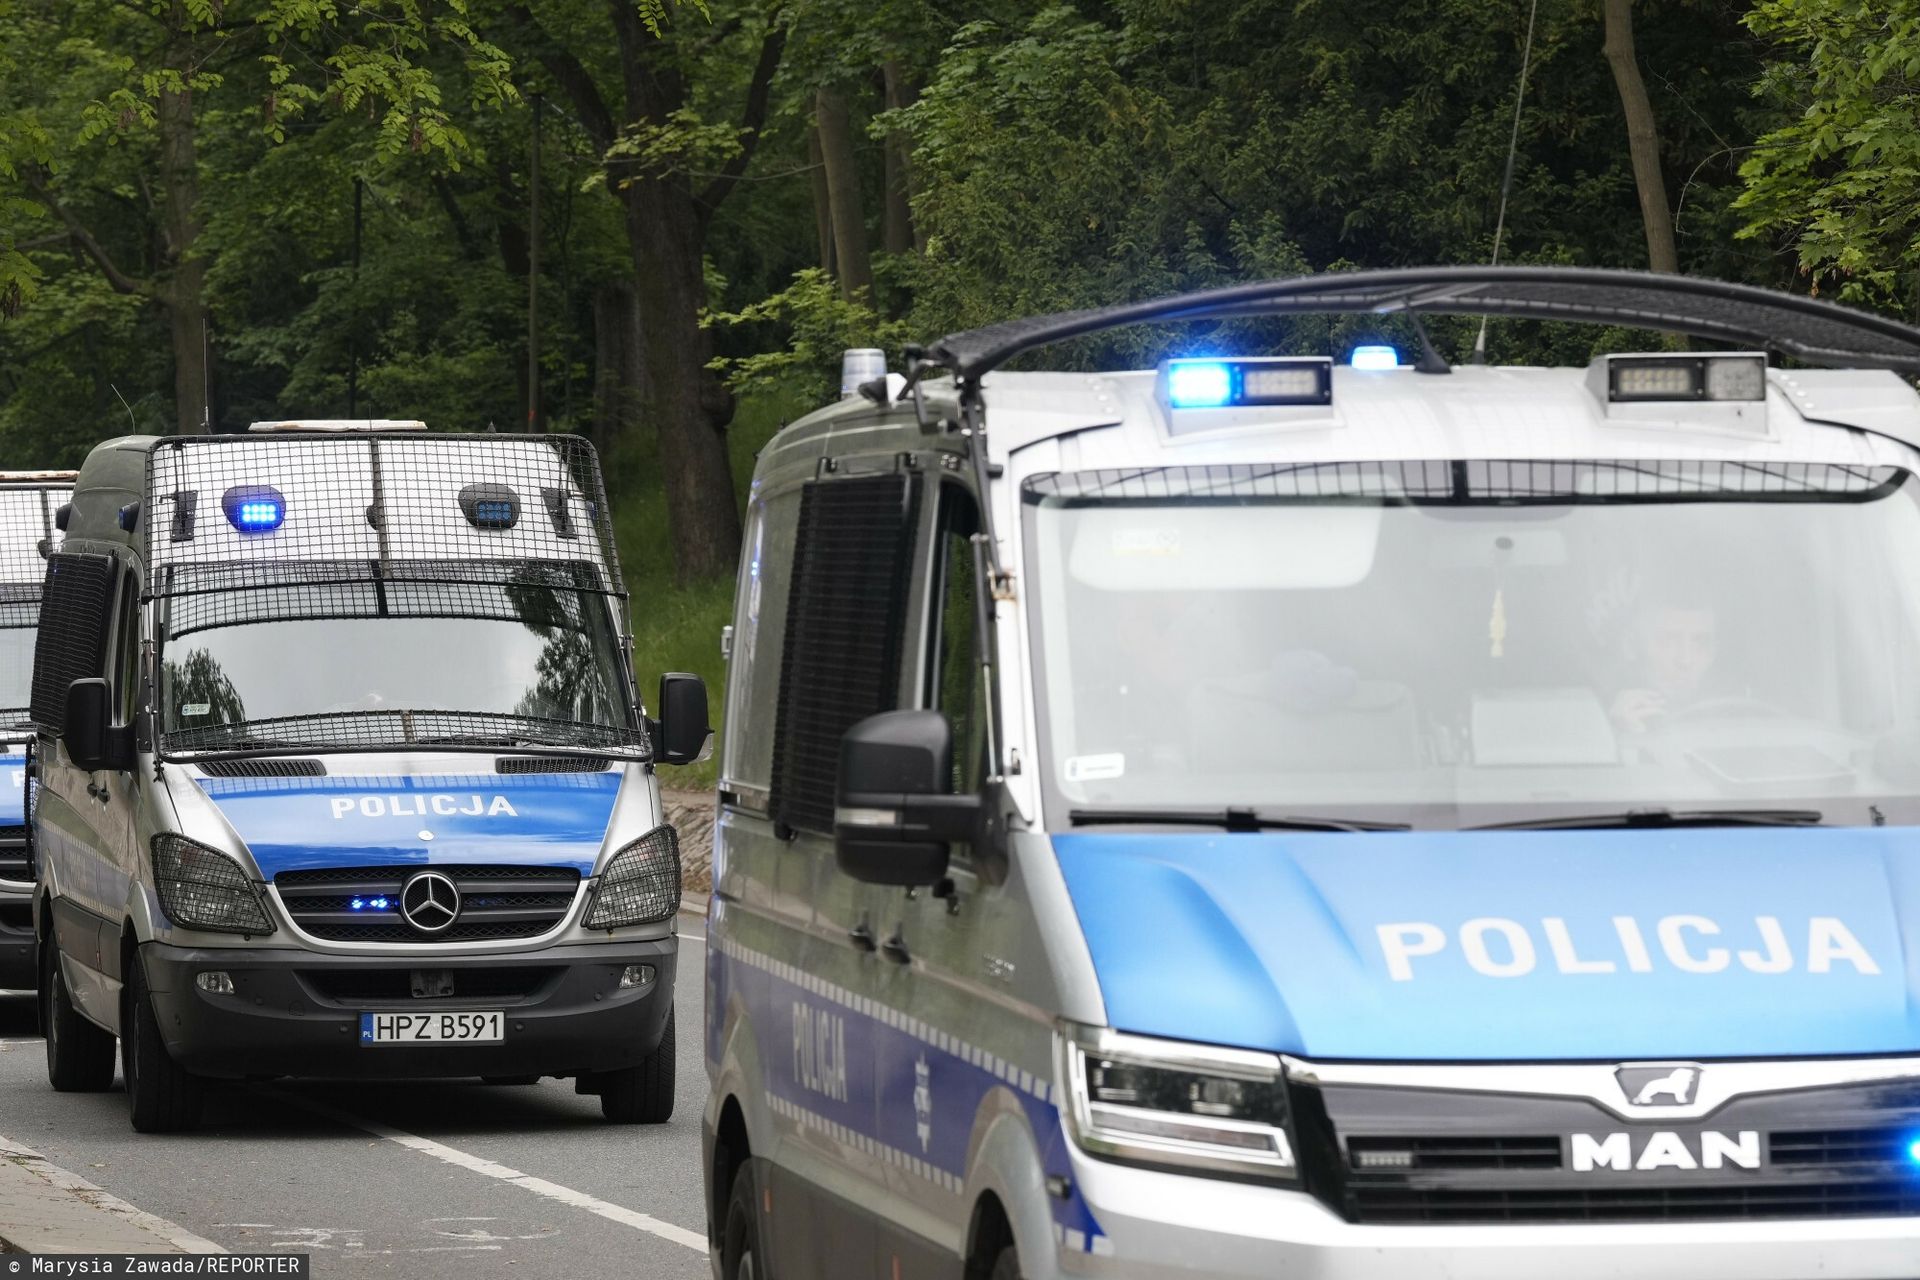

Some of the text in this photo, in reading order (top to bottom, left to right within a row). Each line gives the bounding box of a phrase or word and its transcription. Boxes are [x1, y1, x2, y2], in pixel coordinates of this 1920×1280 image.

[331, 795, 518, 819] POLICJA
[1376, 915, 1882, 982] POLICJA
[377, 1014, 498, 1040] HPZ B591
[793, 1002, 848, 1103] POLICJA
[1571, 1130, 1761, 1172] MAN
